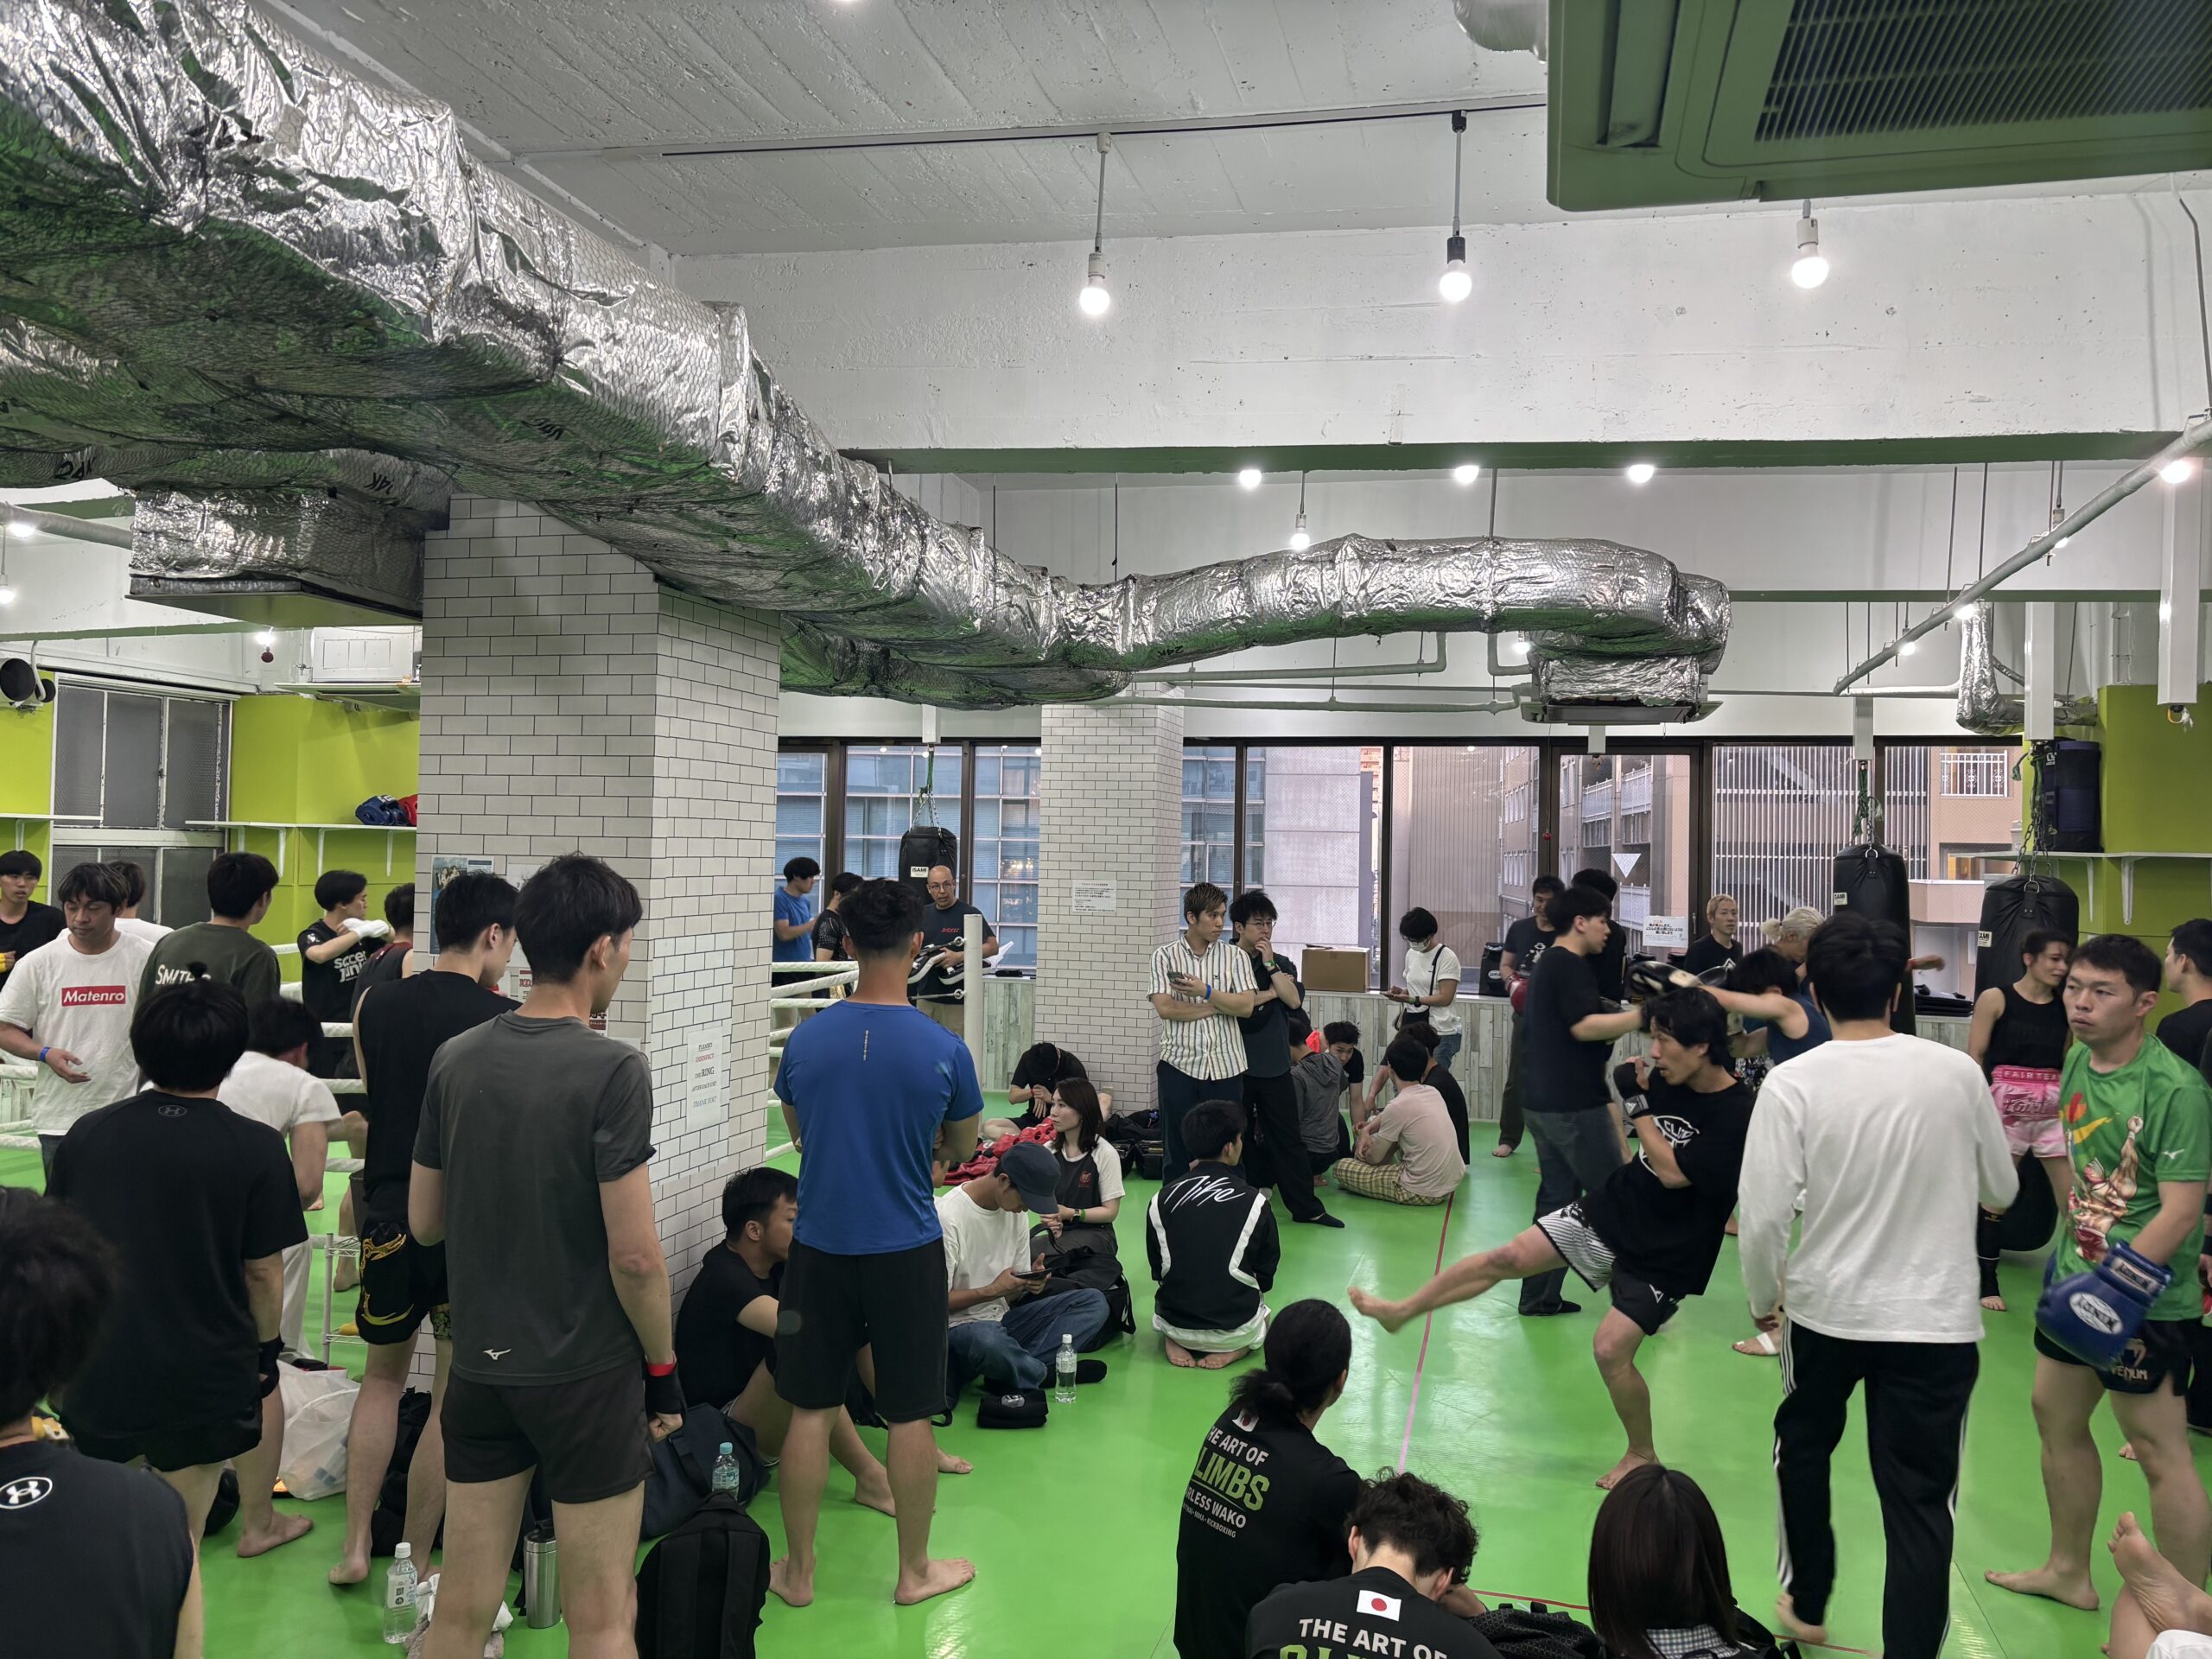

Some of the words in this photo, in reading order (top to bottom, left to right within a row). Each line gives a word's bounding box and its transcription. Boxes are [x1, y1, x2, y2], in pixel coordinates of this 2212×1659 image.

[1157, 645, 1184, 658] 24K
[63, 990, 125, 1003] Matenro
[702, 1067, 715, 1077] RING
[1208, 1426, 1224, 1446] HE
[1218, 1434, 1249, 1458] ART
[1245, 1446, 1269, 1466] OF
[1193, 1446, 1270, 1511] LIMBS
[1211, 1501, 1247, 1529] WAKO
[1206, 1517, 1236, 1538] KICKBOXING
[1299, 1618, 1348, 1643] THE
[1352, 1629, 1407, 1658] ART
